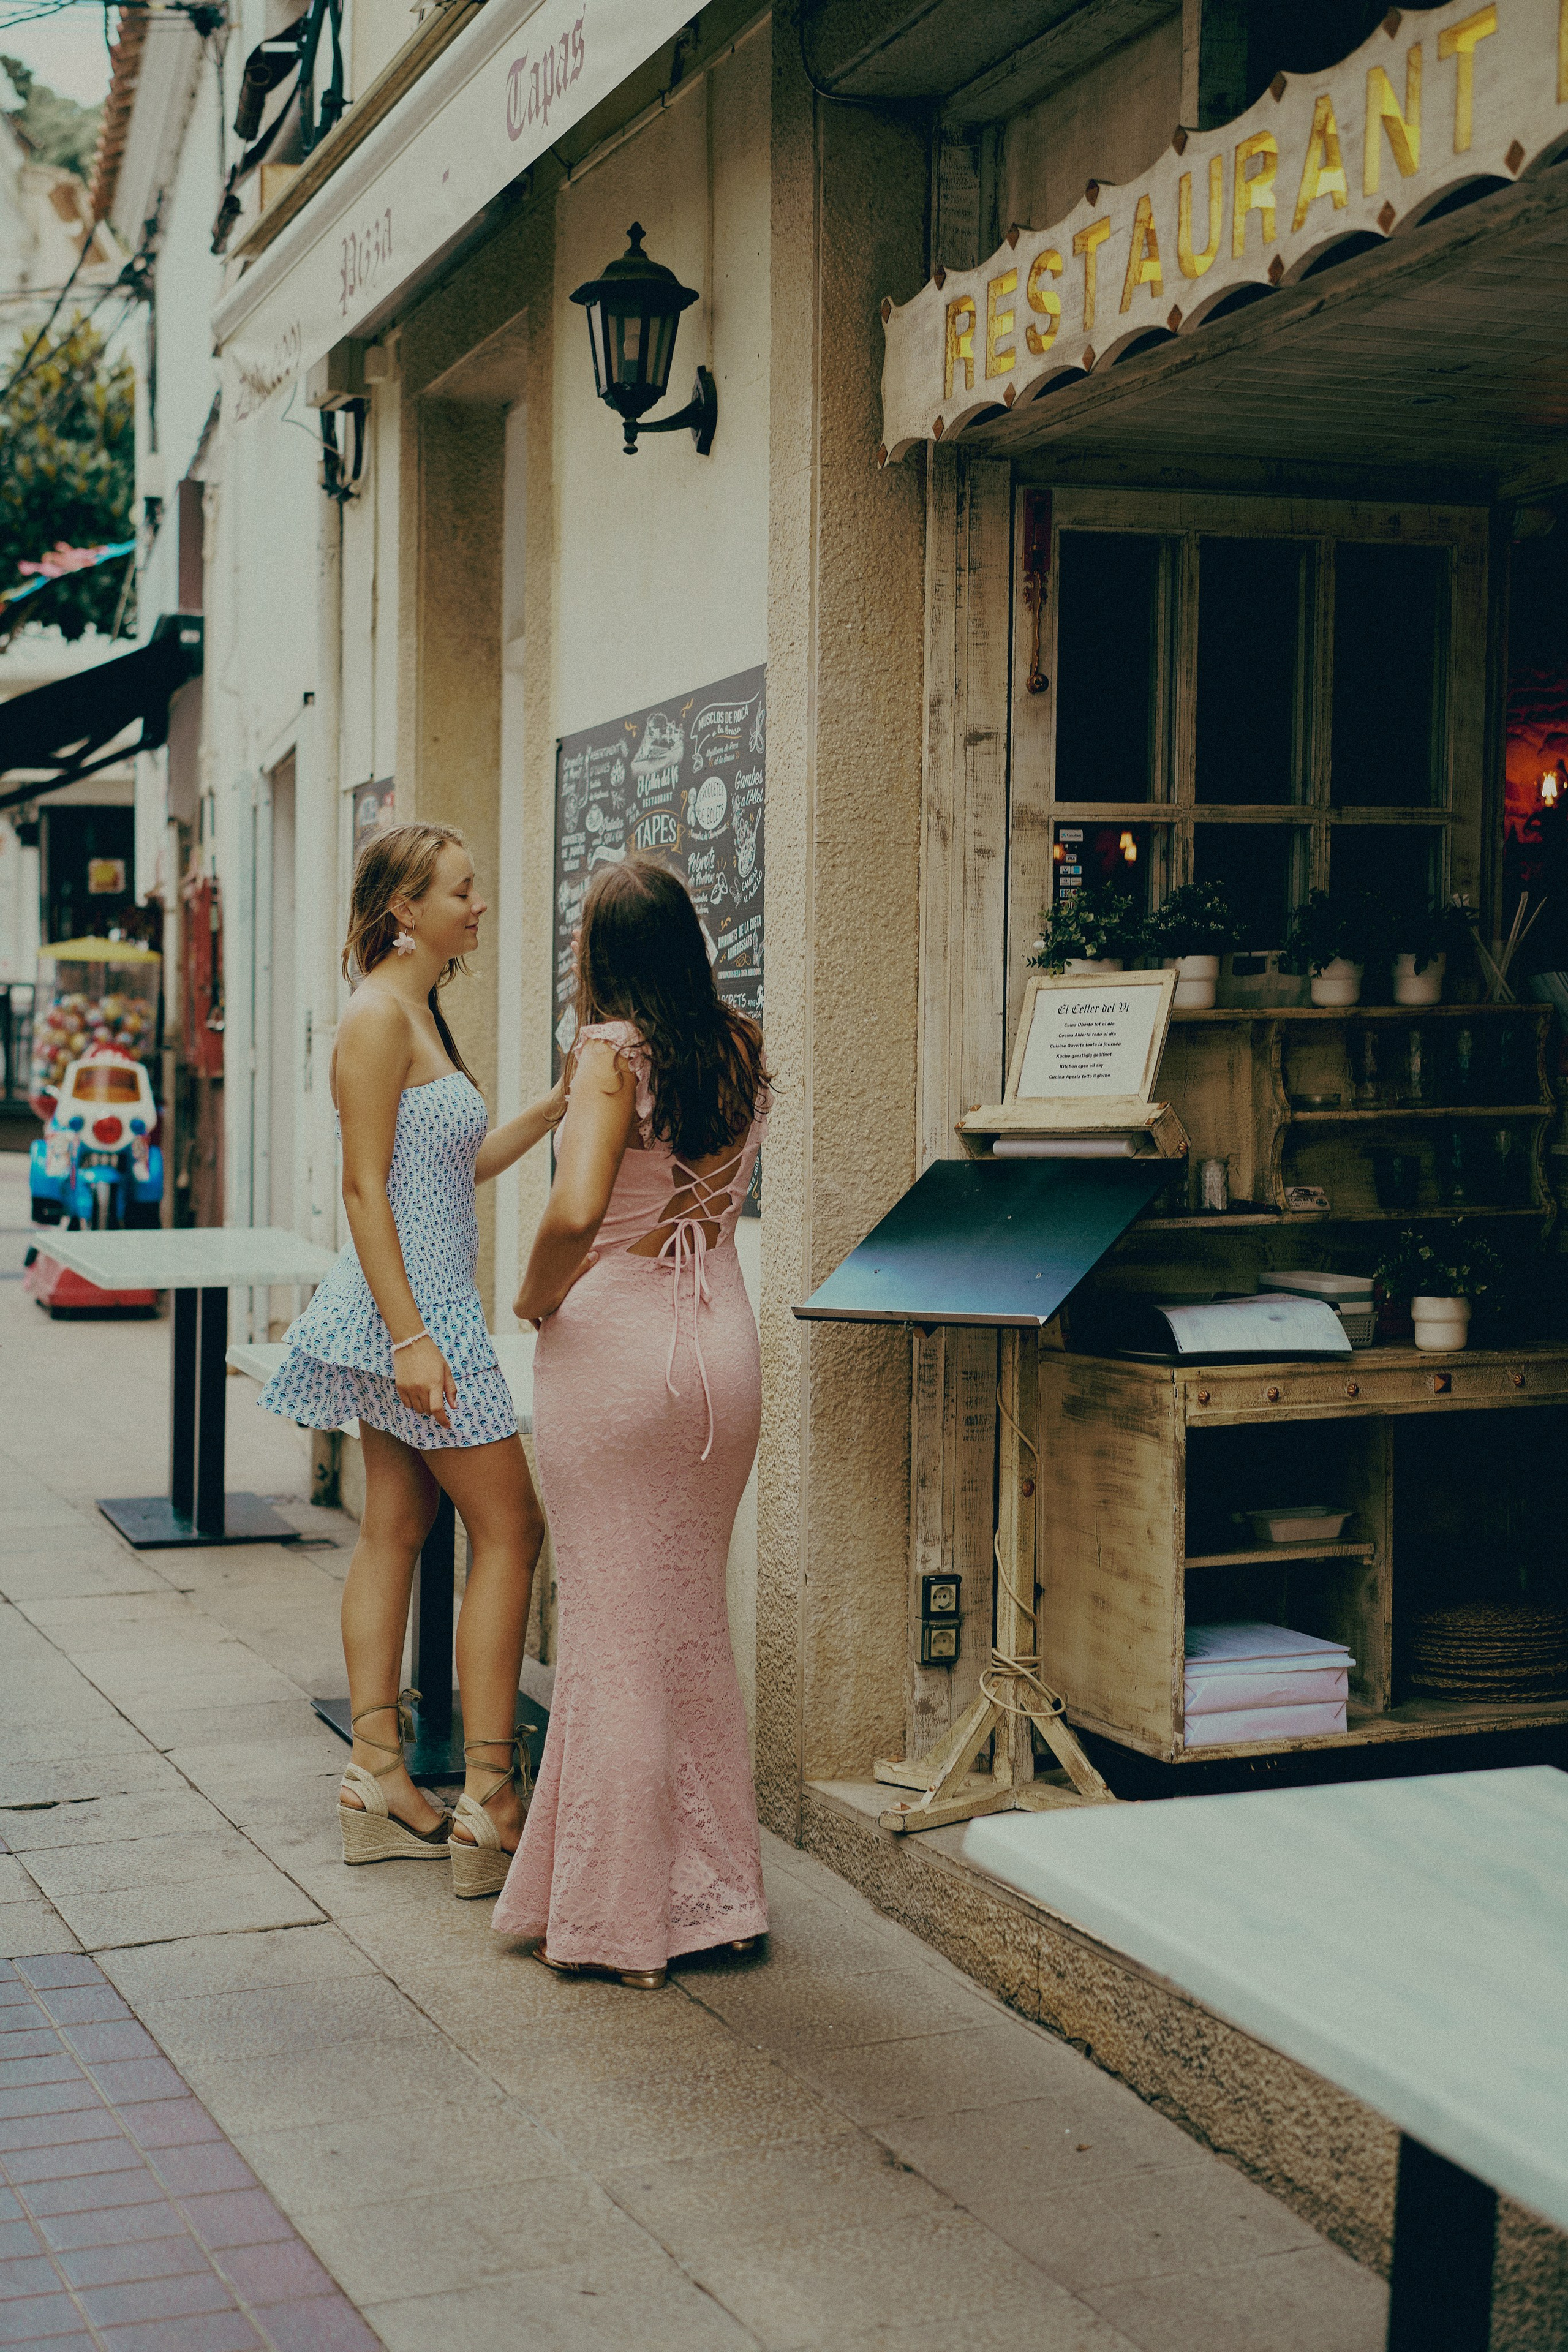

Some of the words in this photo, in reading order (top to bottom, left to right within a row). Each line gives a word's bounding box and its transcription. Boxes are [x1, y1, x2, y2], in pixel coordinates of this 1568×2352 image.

[506, 3, 586, 141] Tapas
[944, 2, 1498, 401] RESTAURANT
[698, 712, 724, 732] MUSCLOS
[725, 712, 733, 723] DE
[734, 704, 748, 723] ROCA
[717, 724, 724, 734] la
[725, 725, 741, 735] brasa
[735, 765, 763, 790] Gambes
[635, 814, 676, 850] TAPES
[742, 867, 758, 891] GAMBAS
[744, 920, 749, 934] LA
[750, 914, 761, 930] COSTA
[1058, 1005, 1069, 1014] El
[1072, 1004, 1099, 1014] Celler
[1102, 1003, 1115, 1013] del
[1119, 1002, 1130, 1012] Vi
